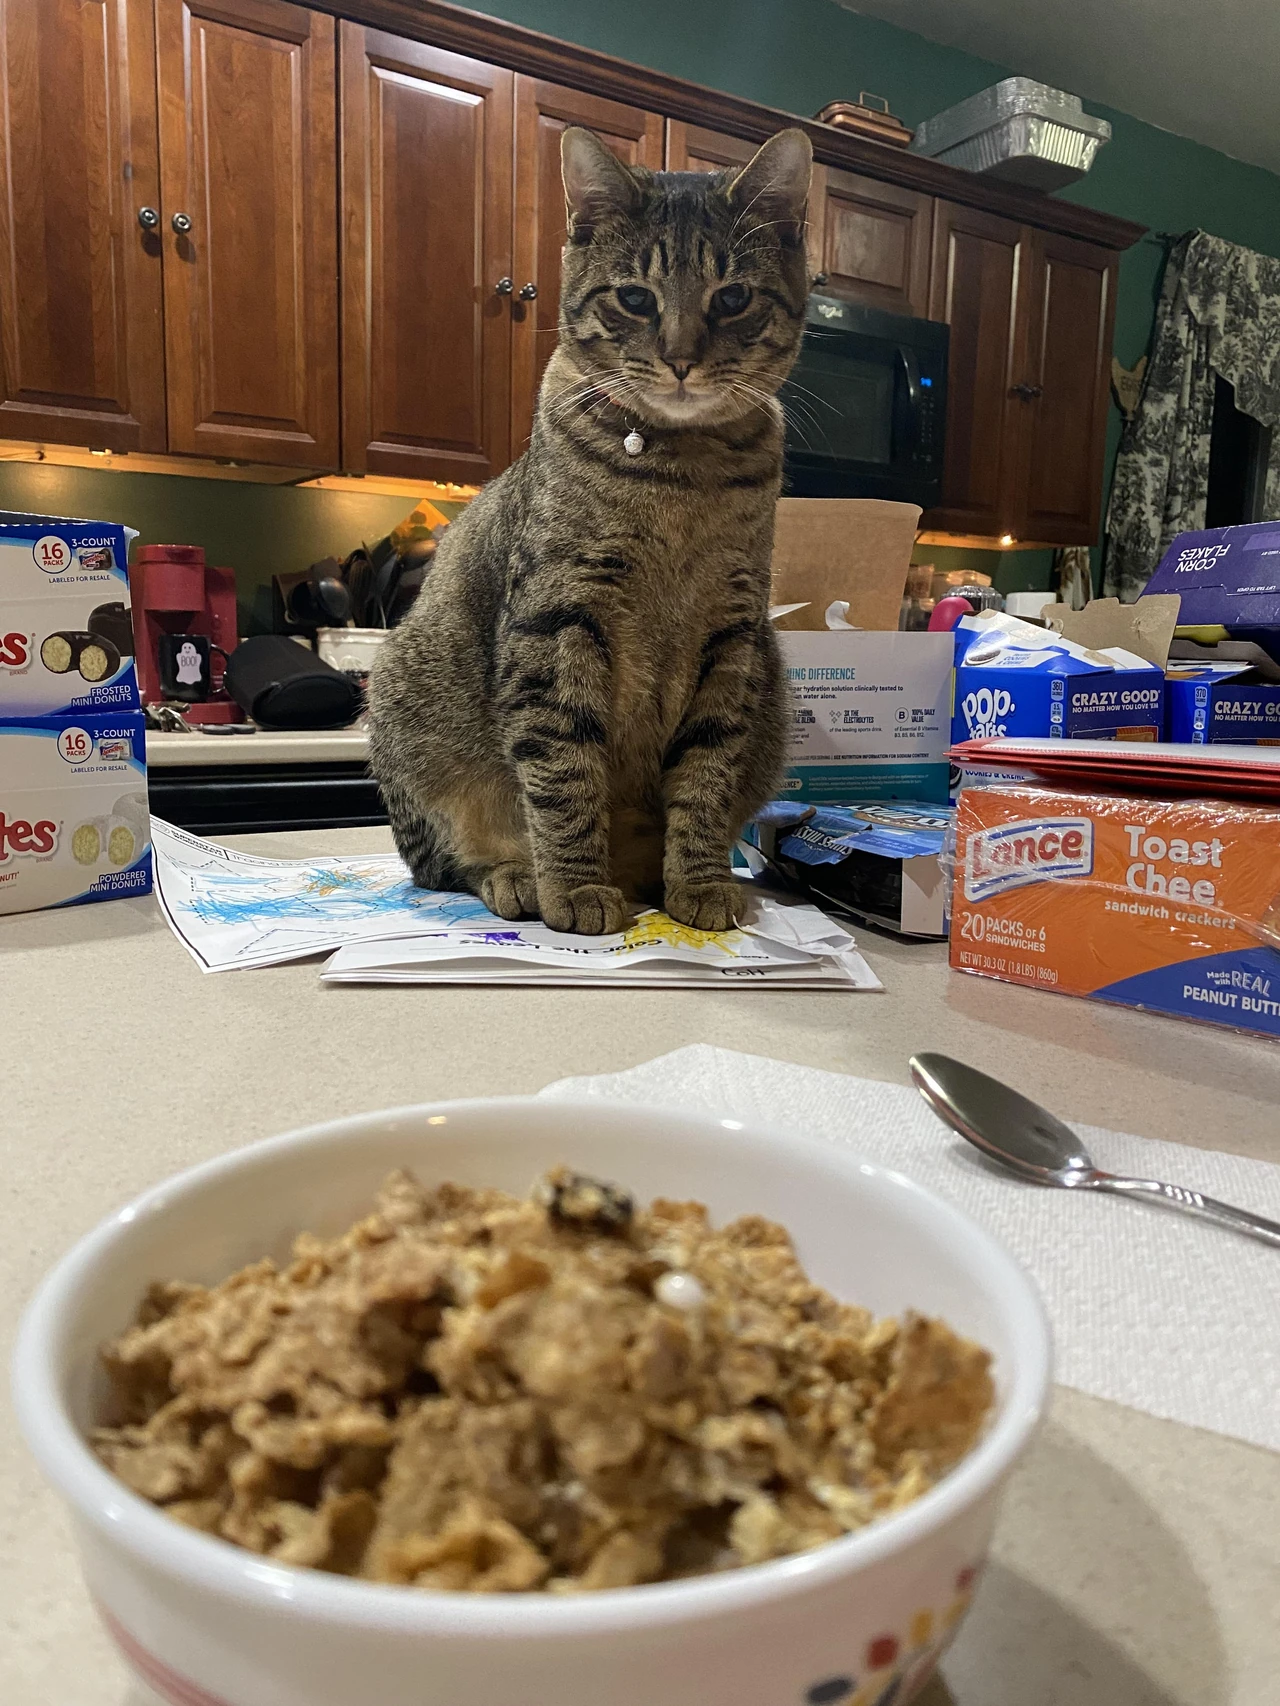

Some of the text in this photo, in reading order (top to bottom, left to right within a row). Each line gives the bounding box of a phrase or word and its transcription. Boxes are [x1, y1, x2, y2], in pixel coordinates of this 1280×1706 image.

[71, 538, 116, 547] 3-COUNT
[41, 543, 63, 560] 16
[1178, 544, 1231, 561] FLAKES
[1175, 558, 1216, 573] CORN
[181, 656, 198, 667] BOO!
[808, 668, 855, 680] DIFFERENCE
[92, 685, 130, 696] FROSTED
[72, 693, 132, 707] MINI DONUTS
[1072, 692, 1118, 706] CRAZY
[1215, 701, 1261, 715] CRAZY
[94, 729, 136, 738] 3-COUNT
[65, 734, 86, 750] 16
[972, 830, 1084, 878] Lance
[1124, 825, 1222, 868] Toast
[99, 870, 146, 883] POWDERED
[1126, 862, 1215, 905] Chee
[90, 878, 146, 892] MINI DONUTS
[1105, 900, 1236, 930] sandwich crackers
[961, 912, 985, 941] 20
[986, 917, 1046, 941] PACKS OF 6
[986, 933, 1046, 952] SANDWICHES
[960, 951, 1058, 984] NET WT 30.3 OZ (1.8 LBS) (860g)
[1232, 970, 1270, 998] REAL
[1183, 985, 1280, 1016] PEANUT BUTT
